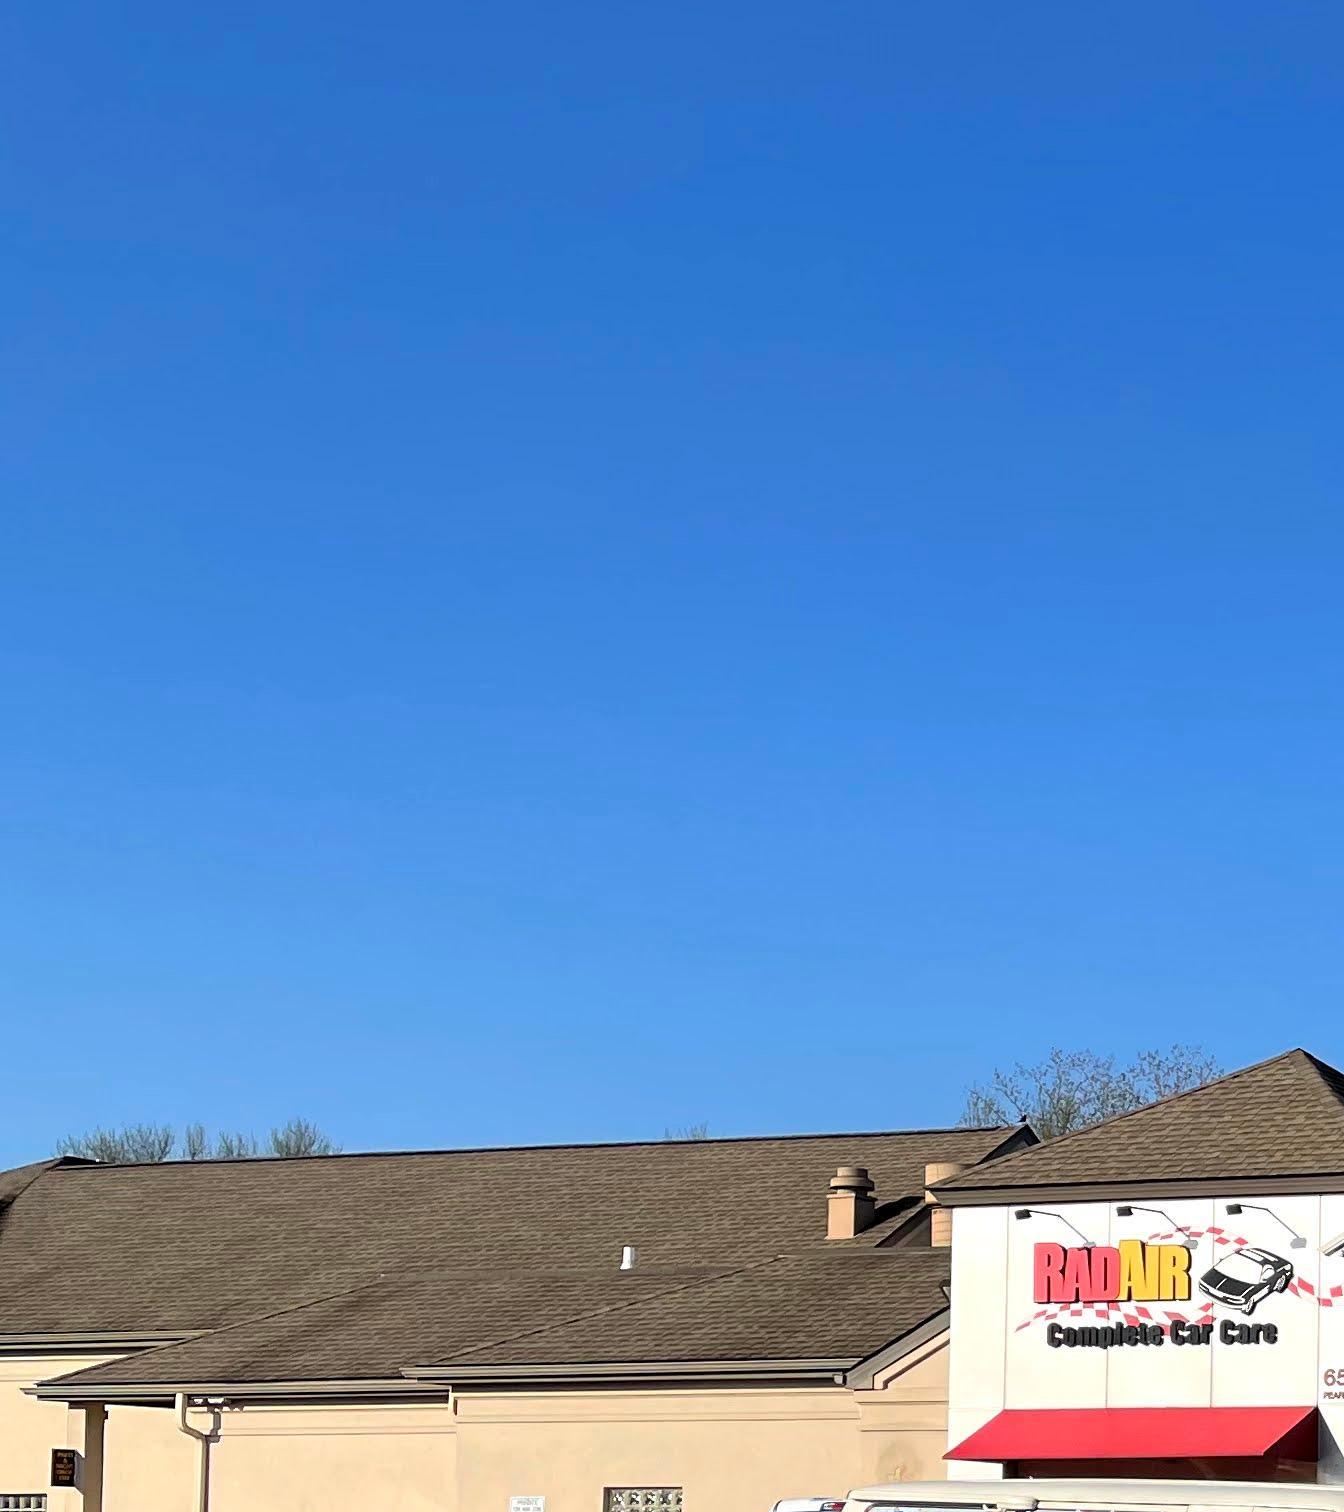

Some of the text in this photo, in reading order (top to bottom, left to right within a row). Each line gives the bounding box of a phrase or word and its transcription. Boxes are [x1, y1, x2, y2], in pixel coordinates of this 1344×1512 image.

[1047, 1319, 1278, 1350] Complete Car Care
